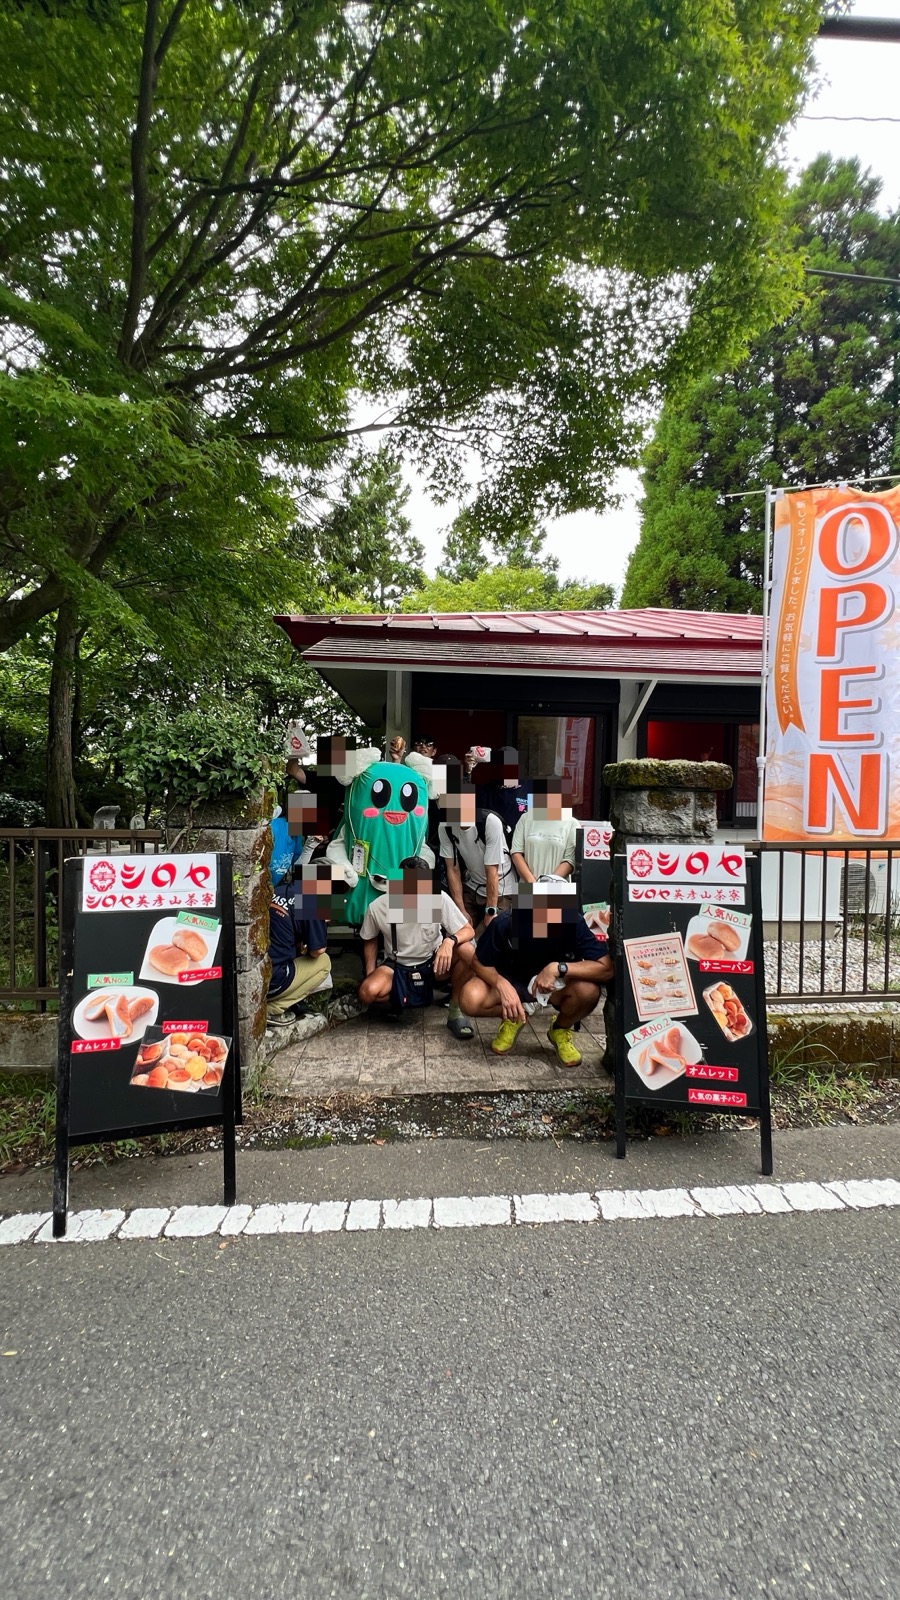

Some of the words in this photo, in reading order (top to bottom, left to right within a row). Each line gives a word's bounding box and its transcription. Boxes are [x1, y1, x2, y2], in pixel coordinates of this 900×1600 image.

[780, 501, 806, 720] 新しくオープンしました。お気軽にご覧ください。
[805, 504, 893, 832] OPEN
[656, 851, 743, 877] シロヤ
[120, 862, 211, 889] シロヤ
[86, 892, 214, 909] シロヤ英彦山茶寮
[631, 888, 740, 902] シロヤ英彦山茶寮
[702, 905, 748, 925] 人気No.1
[701, 961, 751, 972] サニーパン
[94, 975, 129, 984] 人気No.2
[631, 1018, 671, 1044] 人気No.2
[75, 1040, 116, 1051] オムレット
[688, 1067, 735, 1079] オムレット
[690, 1092, 743, 1103] 人気の菓子パン
